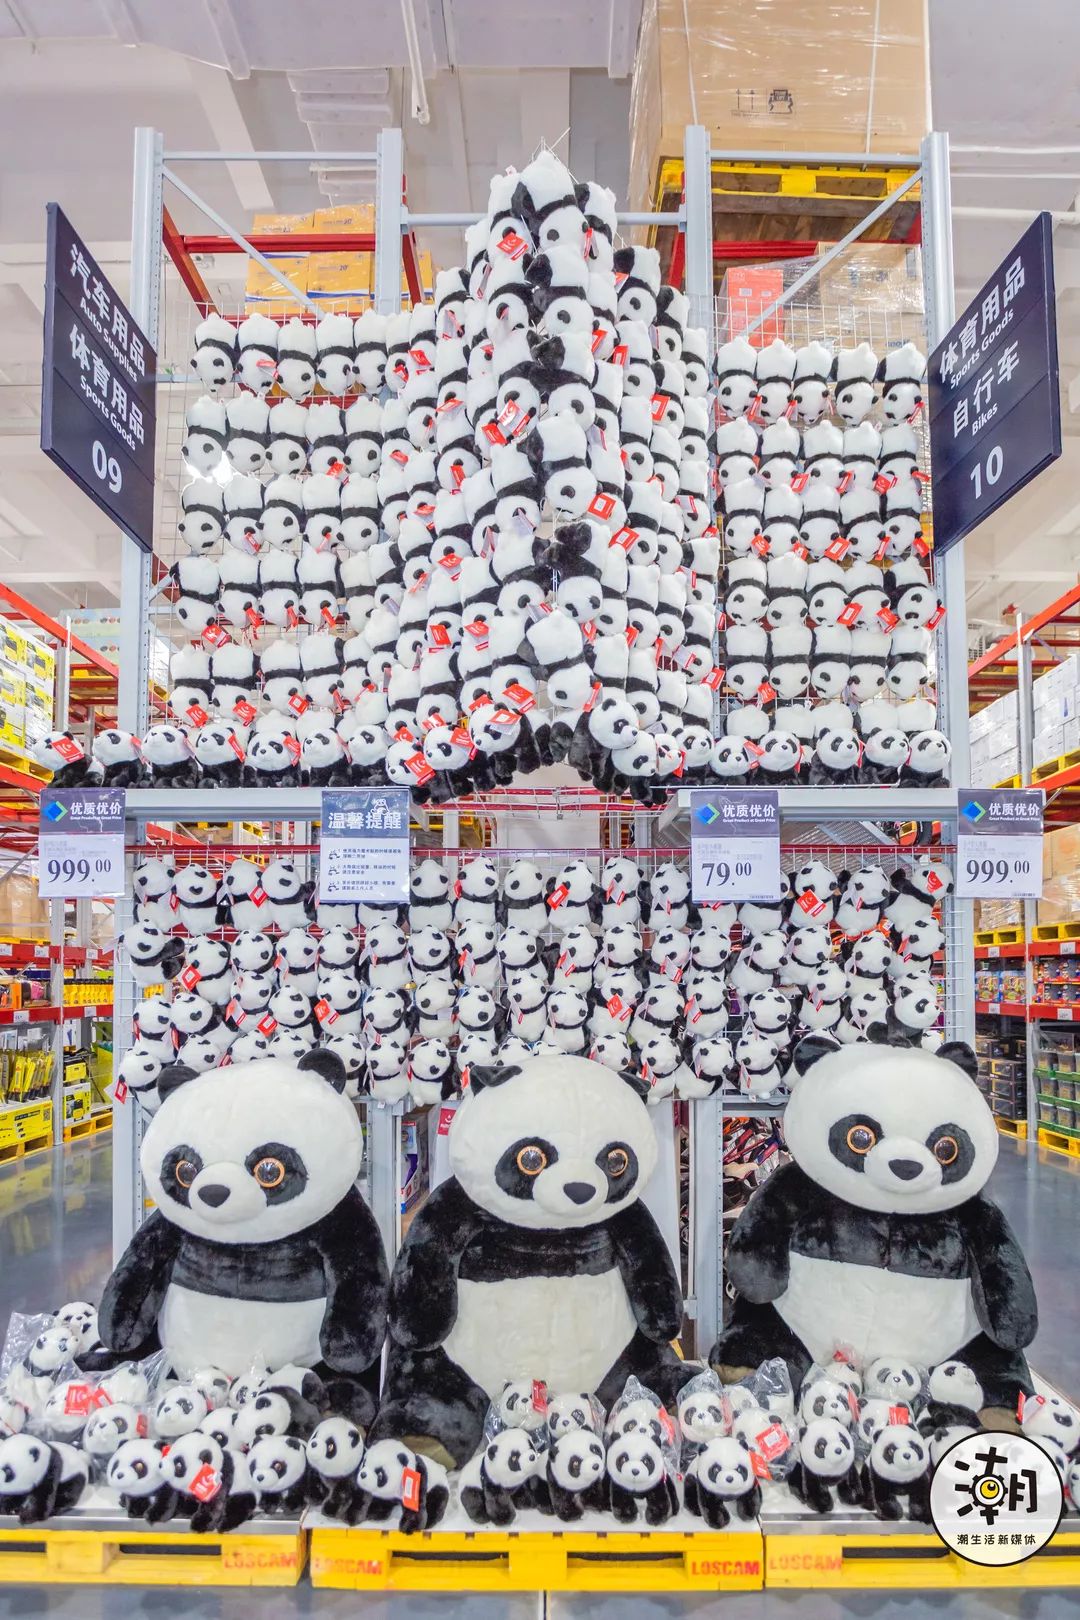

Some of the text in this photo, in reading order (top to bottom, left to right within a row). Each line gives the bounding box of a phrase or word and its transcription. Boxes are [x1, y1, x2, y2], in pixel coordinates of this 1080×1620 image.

[69, 243, 146, 377] 汽车用品
[939, 255, 1026, 382] 体育用品
[80, 296, 138, 383] Auto Supplies
[950, 309, 1014, 390] Sports Goods
[69, 324, 145, 445] 体育用品
[953, 341, 1020, 438] 自行车
[80, 375, 137, 451] Sports Goods
[972, 403, 998, 437] Bikes
[92, 440, 122, 494] 09
[970, 445, 1004, 500] 10
[70, 802, 122, 815] 优质优价
[328, 812, 402, 829] 温馨提醒
[722, 804, 776, 817] 优质优价
[988, 803, 1040, 816] 优质优价
[691, 1560, 760, 1576] LOSCAM
[769, 1553, 844, 1571] LOSCAM
